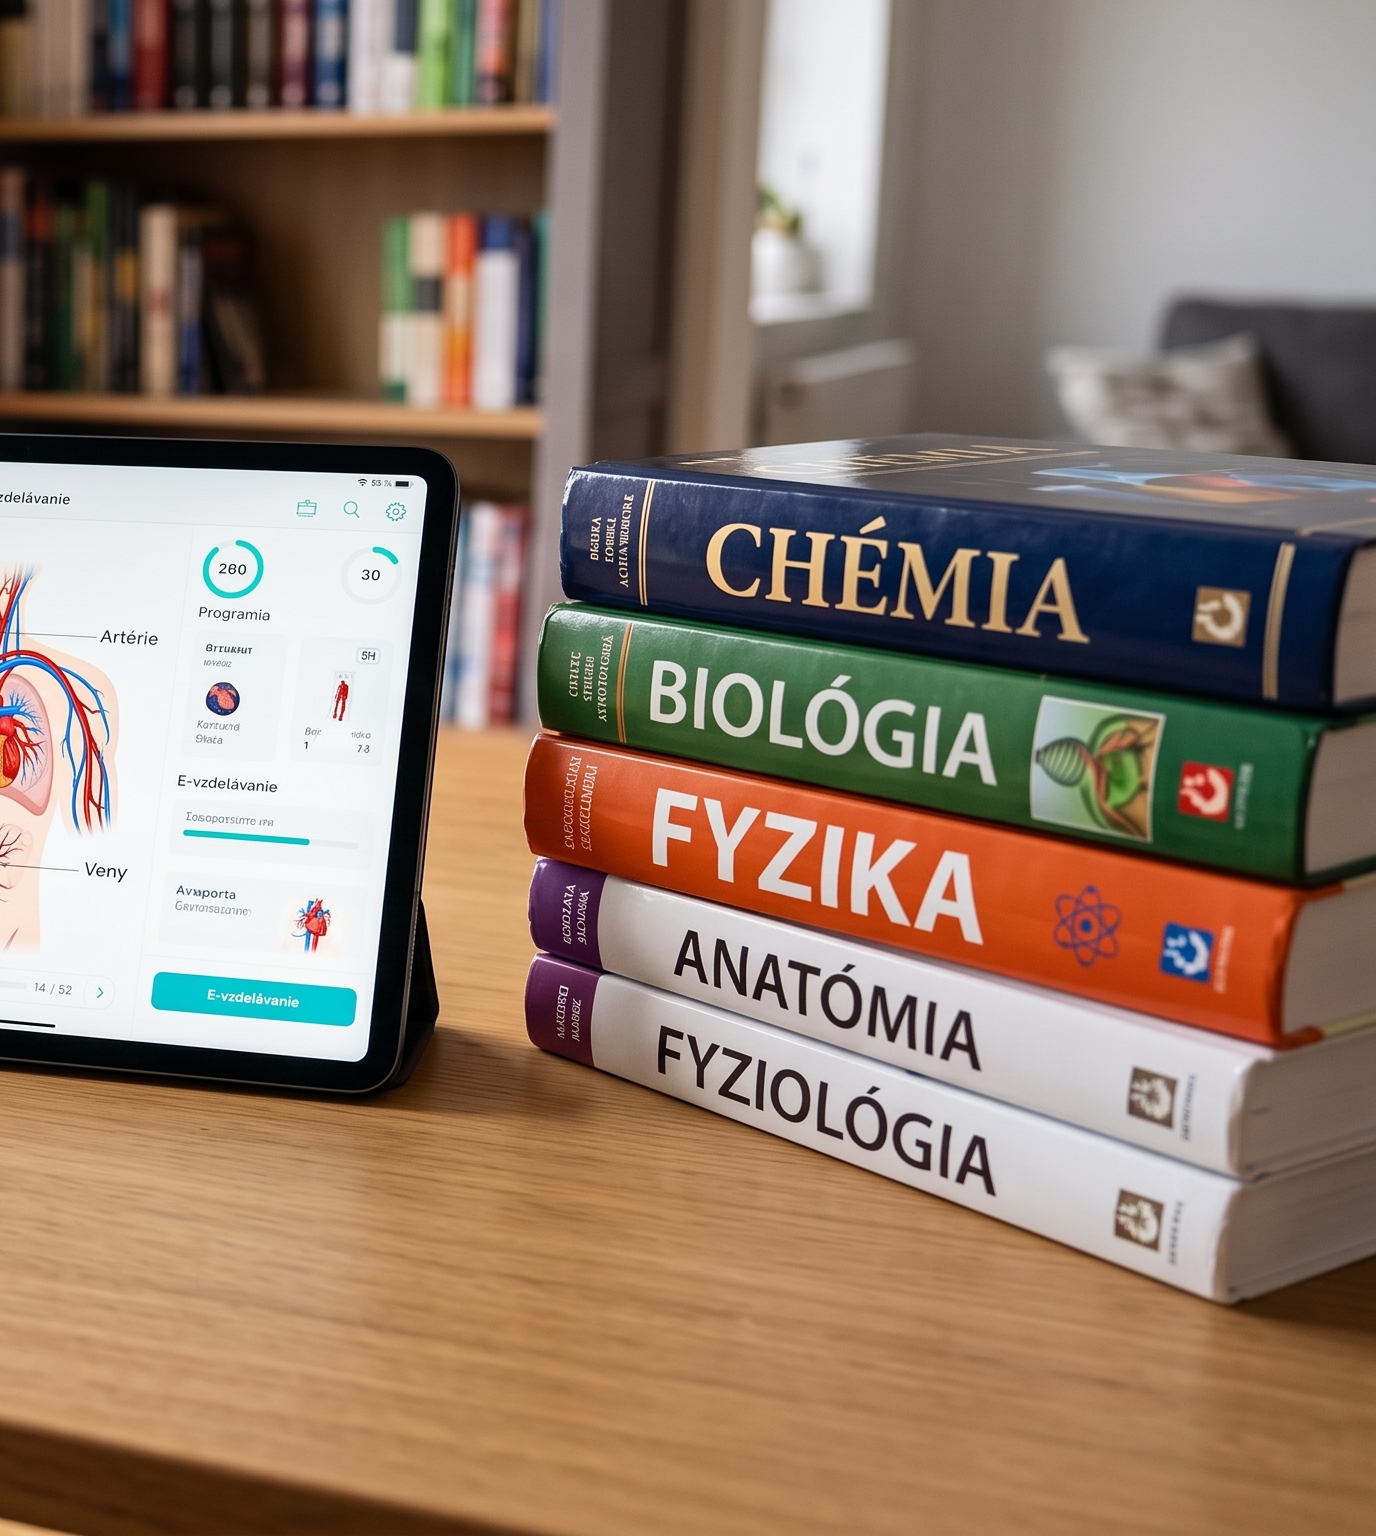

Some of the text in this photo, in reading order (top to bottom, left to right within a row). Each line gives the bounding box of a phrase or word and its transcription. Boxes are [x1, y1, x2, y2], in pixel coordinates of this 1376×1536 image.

[361, 569, 381, 581] 30
[705, 515, 1091, 645] CHÉMIA
[100, 630, 159, 647] Artérie
[648, 660, 998, 787] BIOLÓGIA
[177, 774, 279, 793] E-vzdelávanie
[85, 862, 129, 883] Veny
[652, 787, 984, 946] FYZIKA
[34, 982, 46, 992] 14
[58, 985, 73, 995] 52
[674, 929, 982, 1071] ANATÓMIA
[657, 1025, 997, 1197] FYZIOLÓGIA
